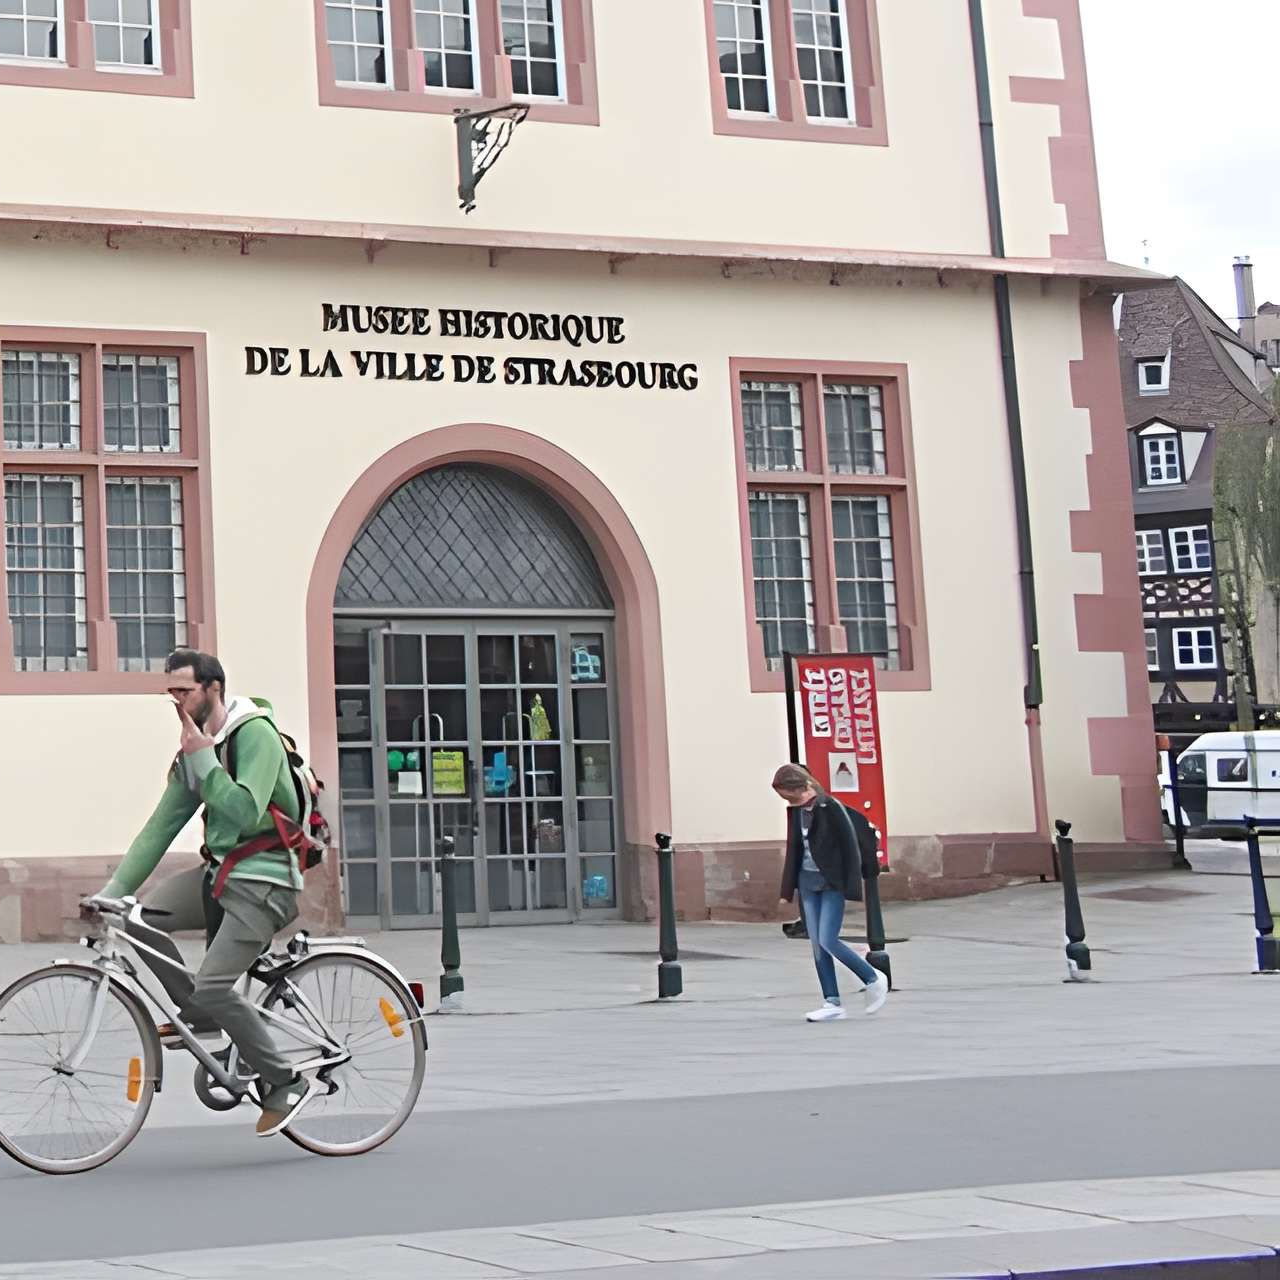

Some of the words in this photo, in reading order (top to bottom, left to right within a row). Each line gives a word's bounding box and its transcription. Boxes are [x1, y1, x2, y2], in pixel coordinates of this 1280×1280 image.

[321, 303, 432, 335] MUSEE
[438, 309, 626, 347] HISTORIQUE
[245, 346, 291, 376] DE
[299, 348, 343, 378] LA
[350, 351, 444, 382] VILLE
[451, 354, 497, 384] DE
[503, 357, 699, 391] STRASBOURG
